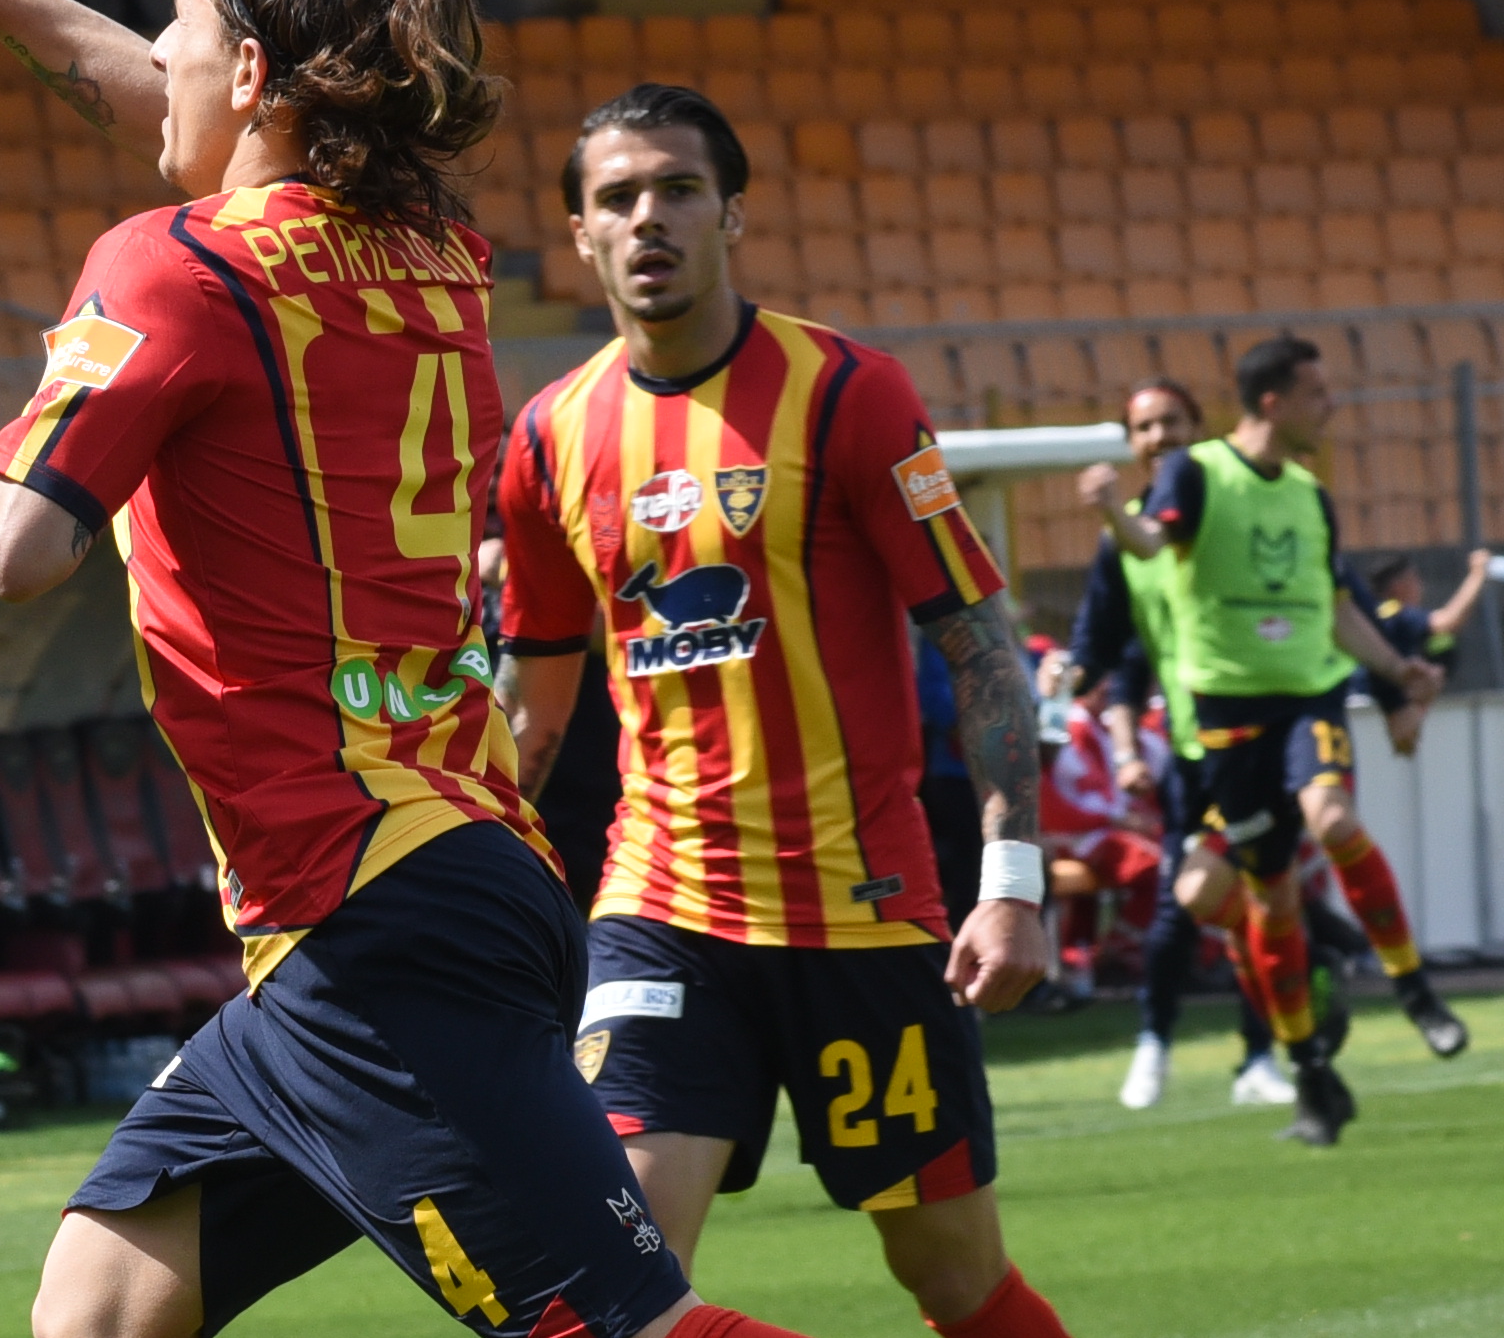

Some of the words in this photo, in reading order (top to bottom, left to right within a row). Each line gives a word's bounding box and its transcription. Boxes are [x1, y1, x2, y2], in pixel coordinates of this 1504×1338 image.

[241, 213, 490, 291] PETRICCION
[390, 351, 475, 636] 4
[628, 618, 766, 675] MOBY
[819, 1023, 939, 1148] 24
[413, 1196, 510, 1328] 4
